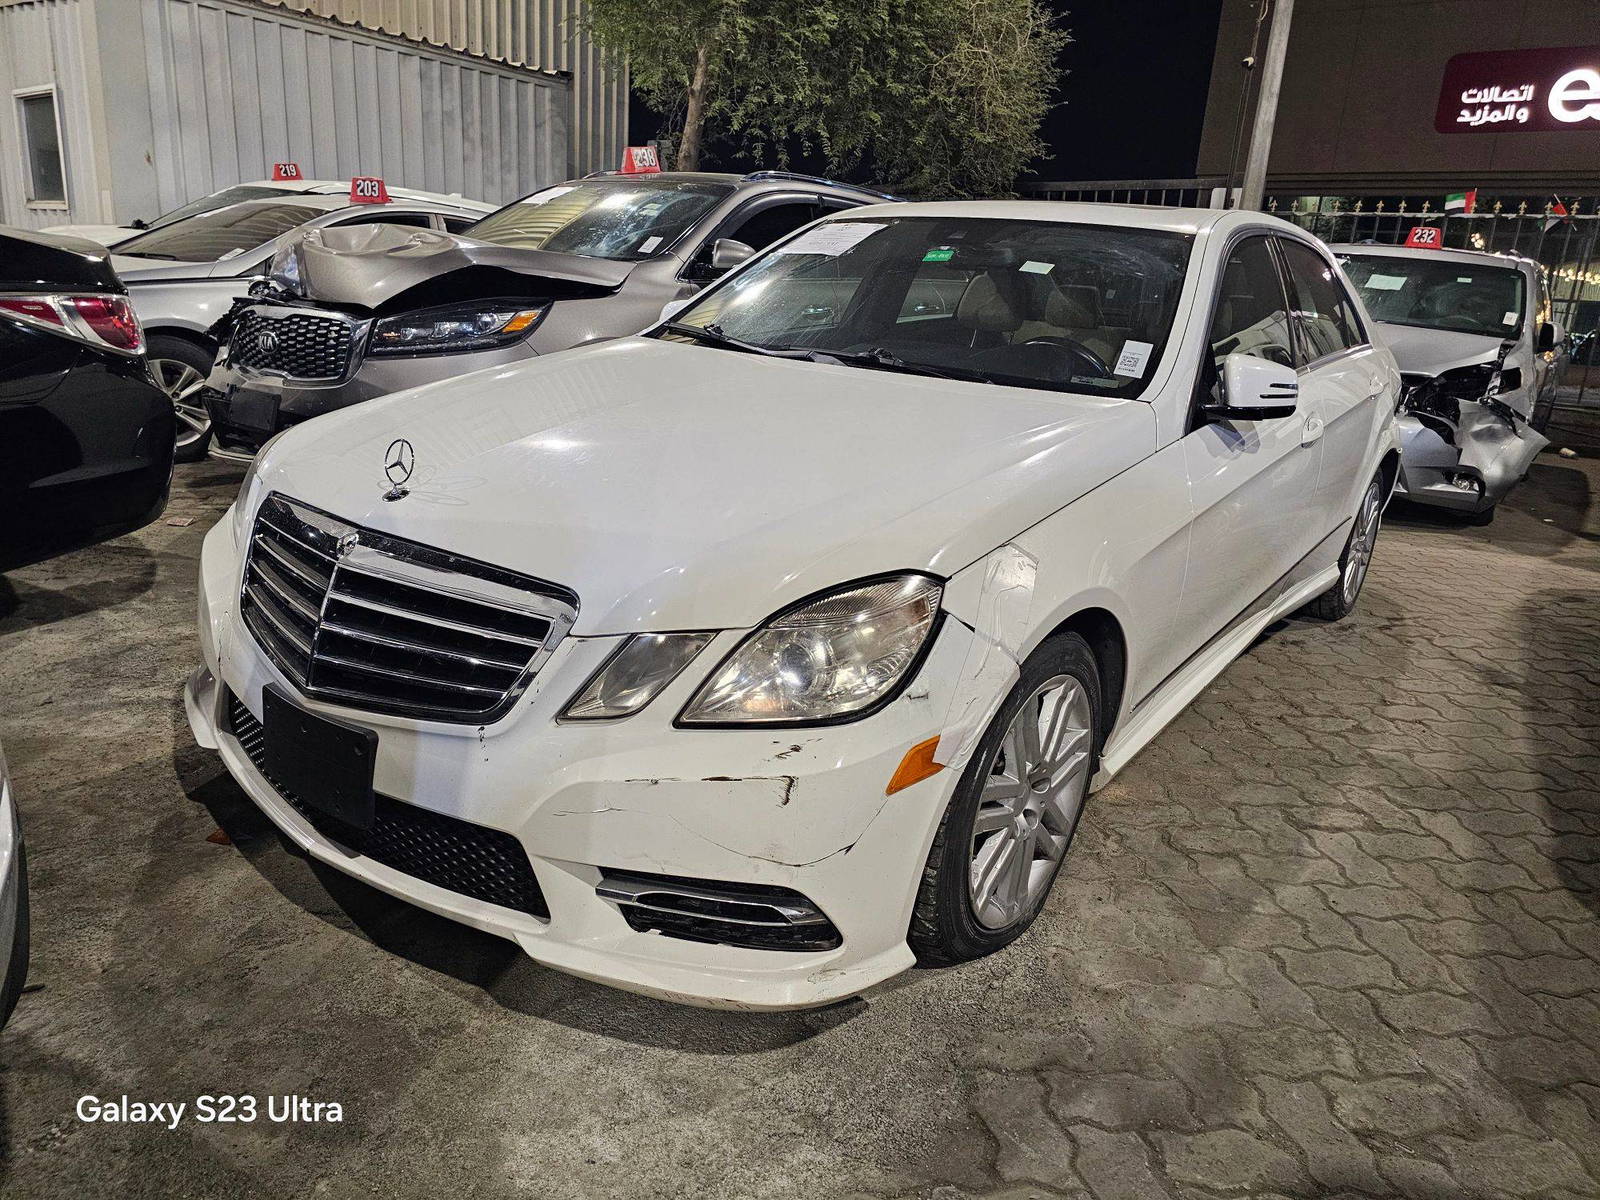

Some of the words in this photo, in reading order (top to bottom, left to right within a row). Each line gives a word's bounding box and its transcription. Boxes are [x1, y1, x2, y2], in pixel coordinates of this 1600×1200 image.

[1461, 84, 1534, 104] اتصالات
[1456, 103, 1530, 126] والمزيد
[634, 148, 656, 167] 238
[279, 164, 297, 177] 219
[356, 180, 379, 197] 203
[1413, 229, 1436, 243] 232
[259, 335, 274, 350] KIA
